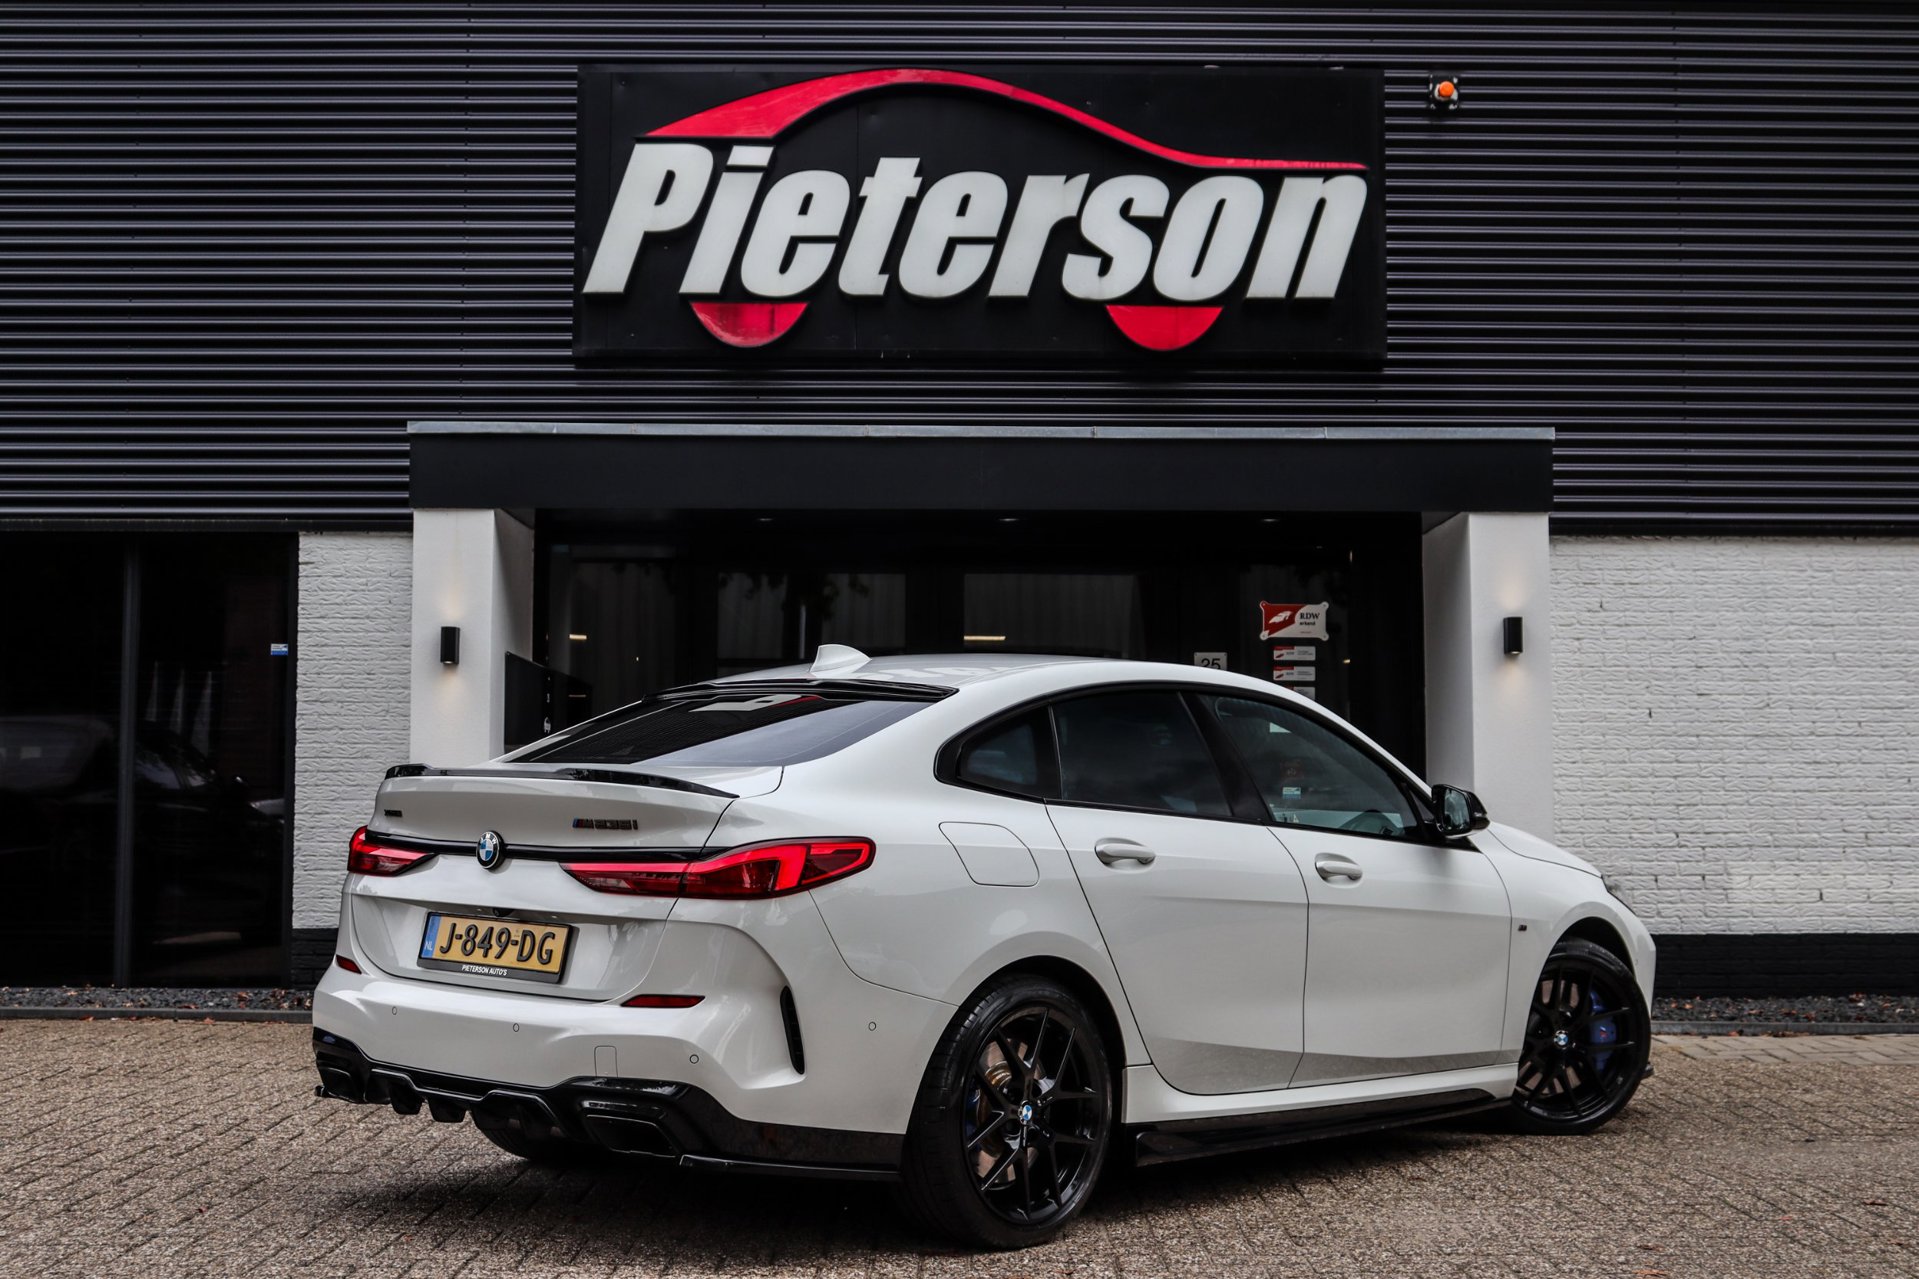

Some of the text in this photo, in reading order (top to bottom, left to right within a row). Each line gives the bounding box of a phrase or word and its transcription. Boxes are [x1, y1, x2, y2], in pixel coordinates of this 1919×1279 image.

[583, 142, 1367, 301] Pieterson
[1300, 612, 1320, 620] RDW
[424, 941, 433, 951] NL
[439, 922, 556, 966] J-849-DG
[461, 964, 508, 976] PIETERSON AUTO'S
